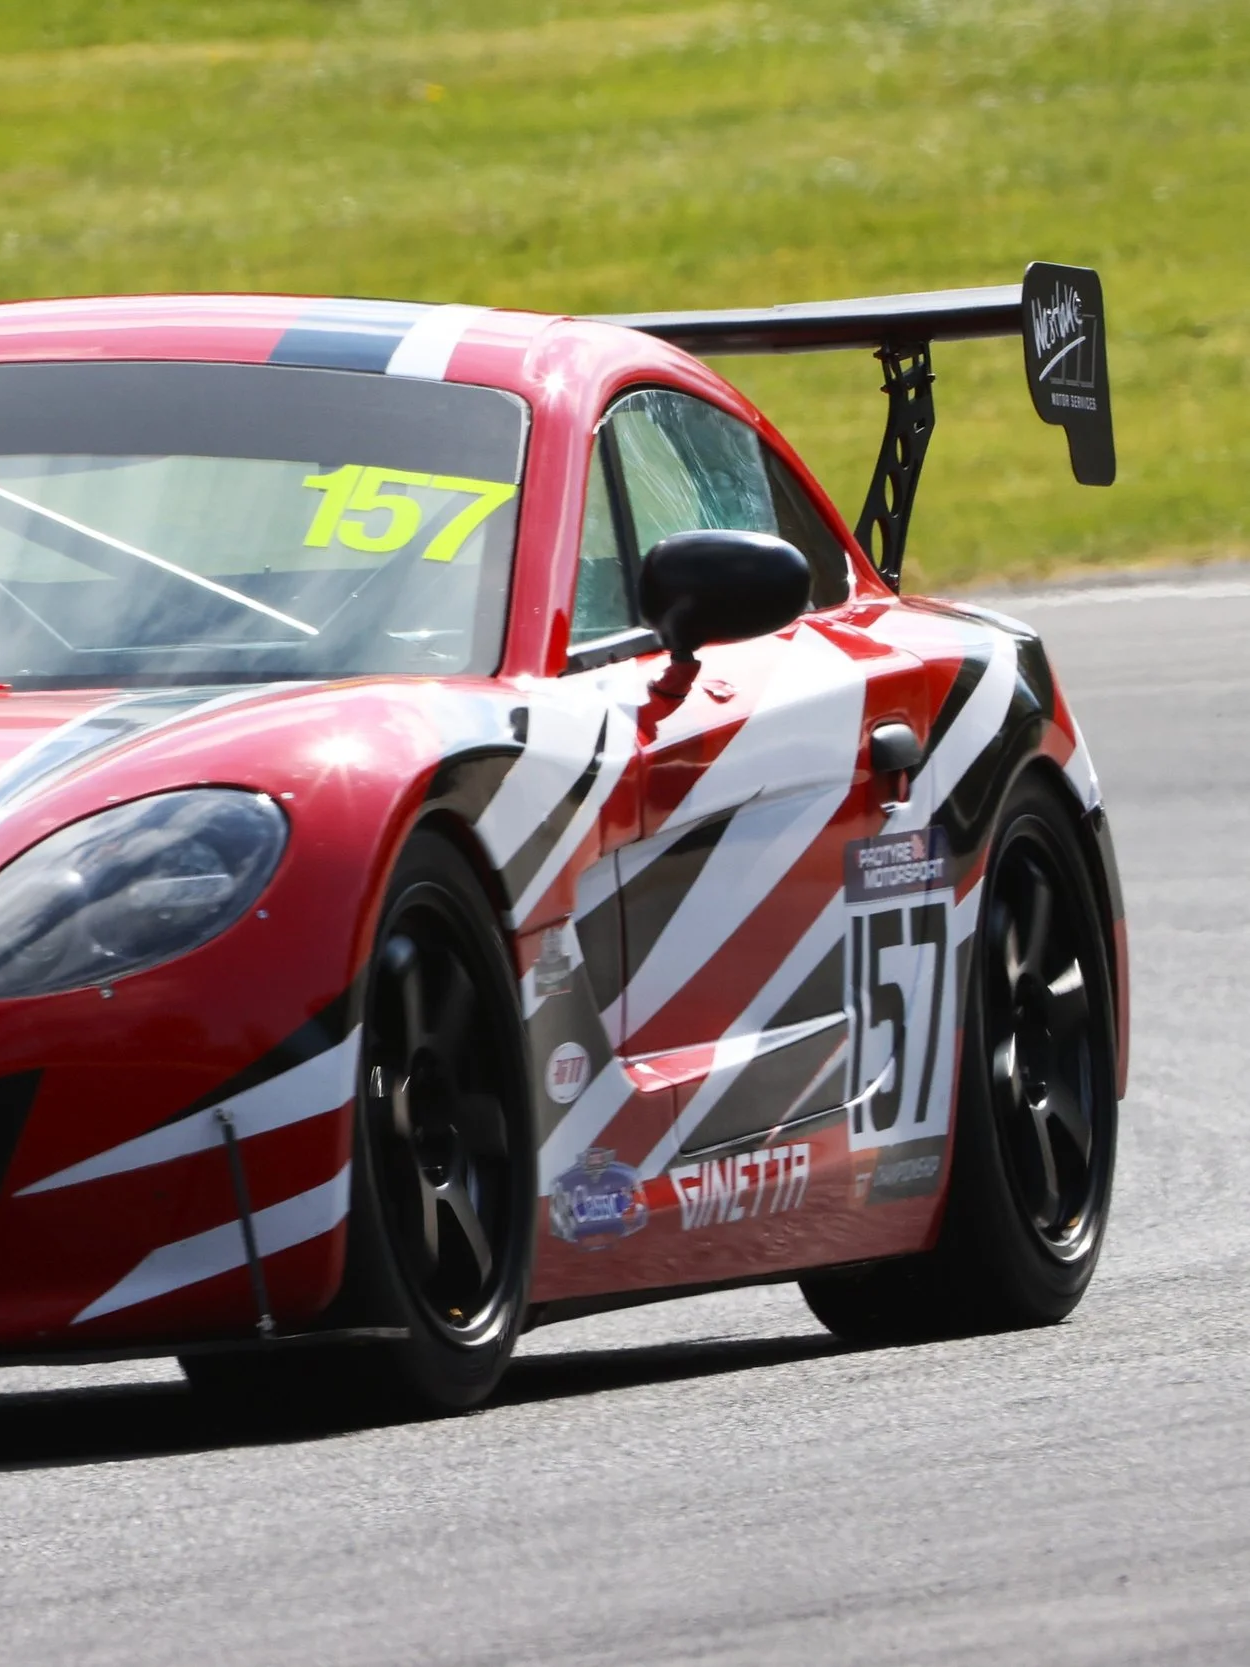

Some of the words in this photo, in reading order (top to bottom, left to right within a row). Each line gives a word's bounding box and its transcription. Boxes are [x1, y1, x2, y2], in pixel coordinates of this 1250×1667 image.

[302, 464, 517, 562] 157
[858, 841, 913, 868] PROTYRE
[863, 858, 944, 889] MOTORSPORT
[851, 902, 947, 1134] 157
[669, 1143, 810, 1231] GINETTA
